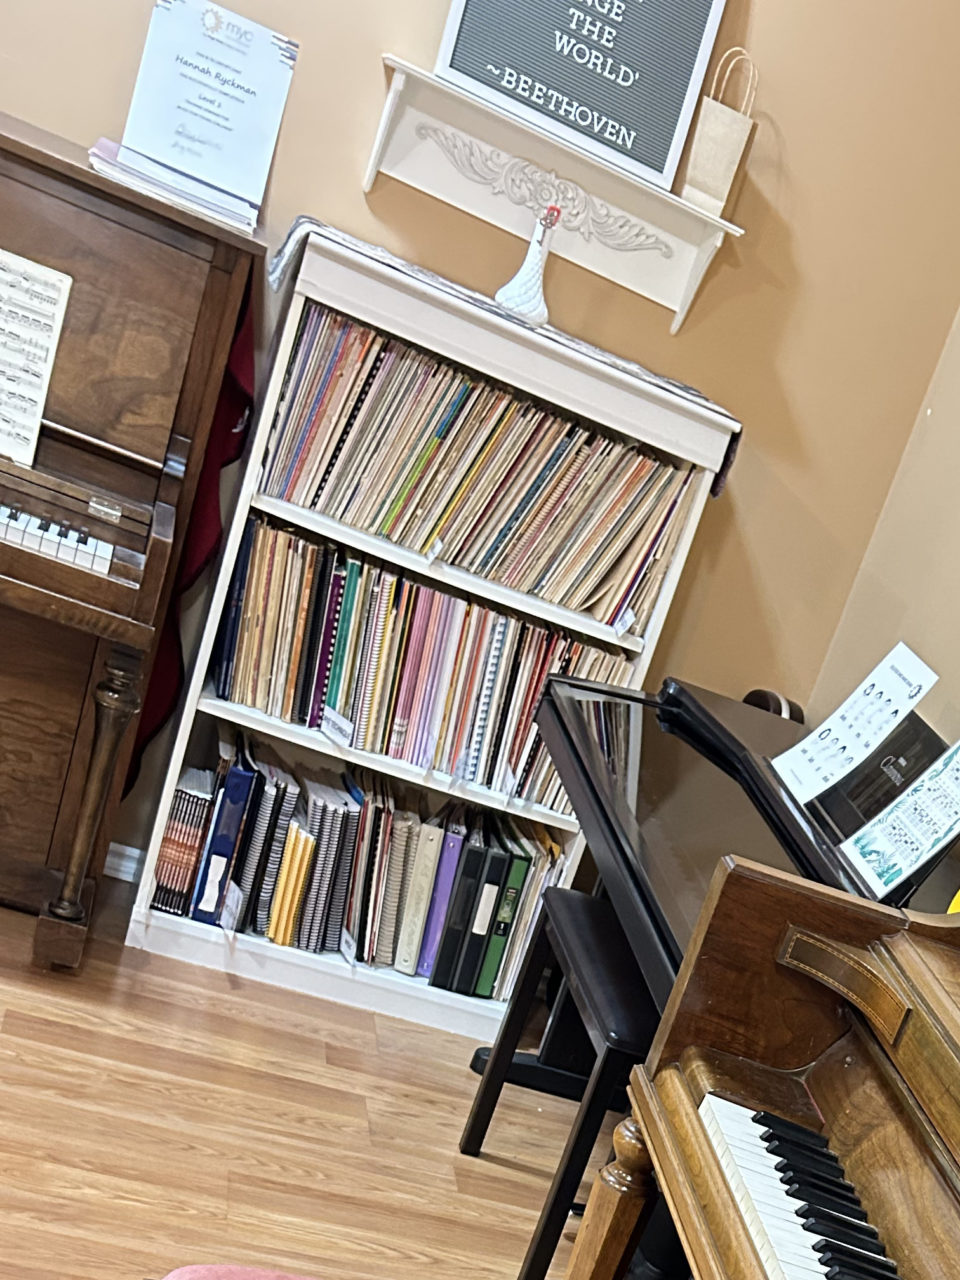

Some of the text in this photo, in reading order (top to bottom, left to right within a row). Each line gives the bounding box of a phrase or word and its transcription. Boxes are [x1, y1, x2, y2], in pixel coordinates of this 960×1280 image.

[568, 7, 617, 48] THE
[175, 54, 212, 77] Hannah
[214, 71, 257, 97] Ryckman
